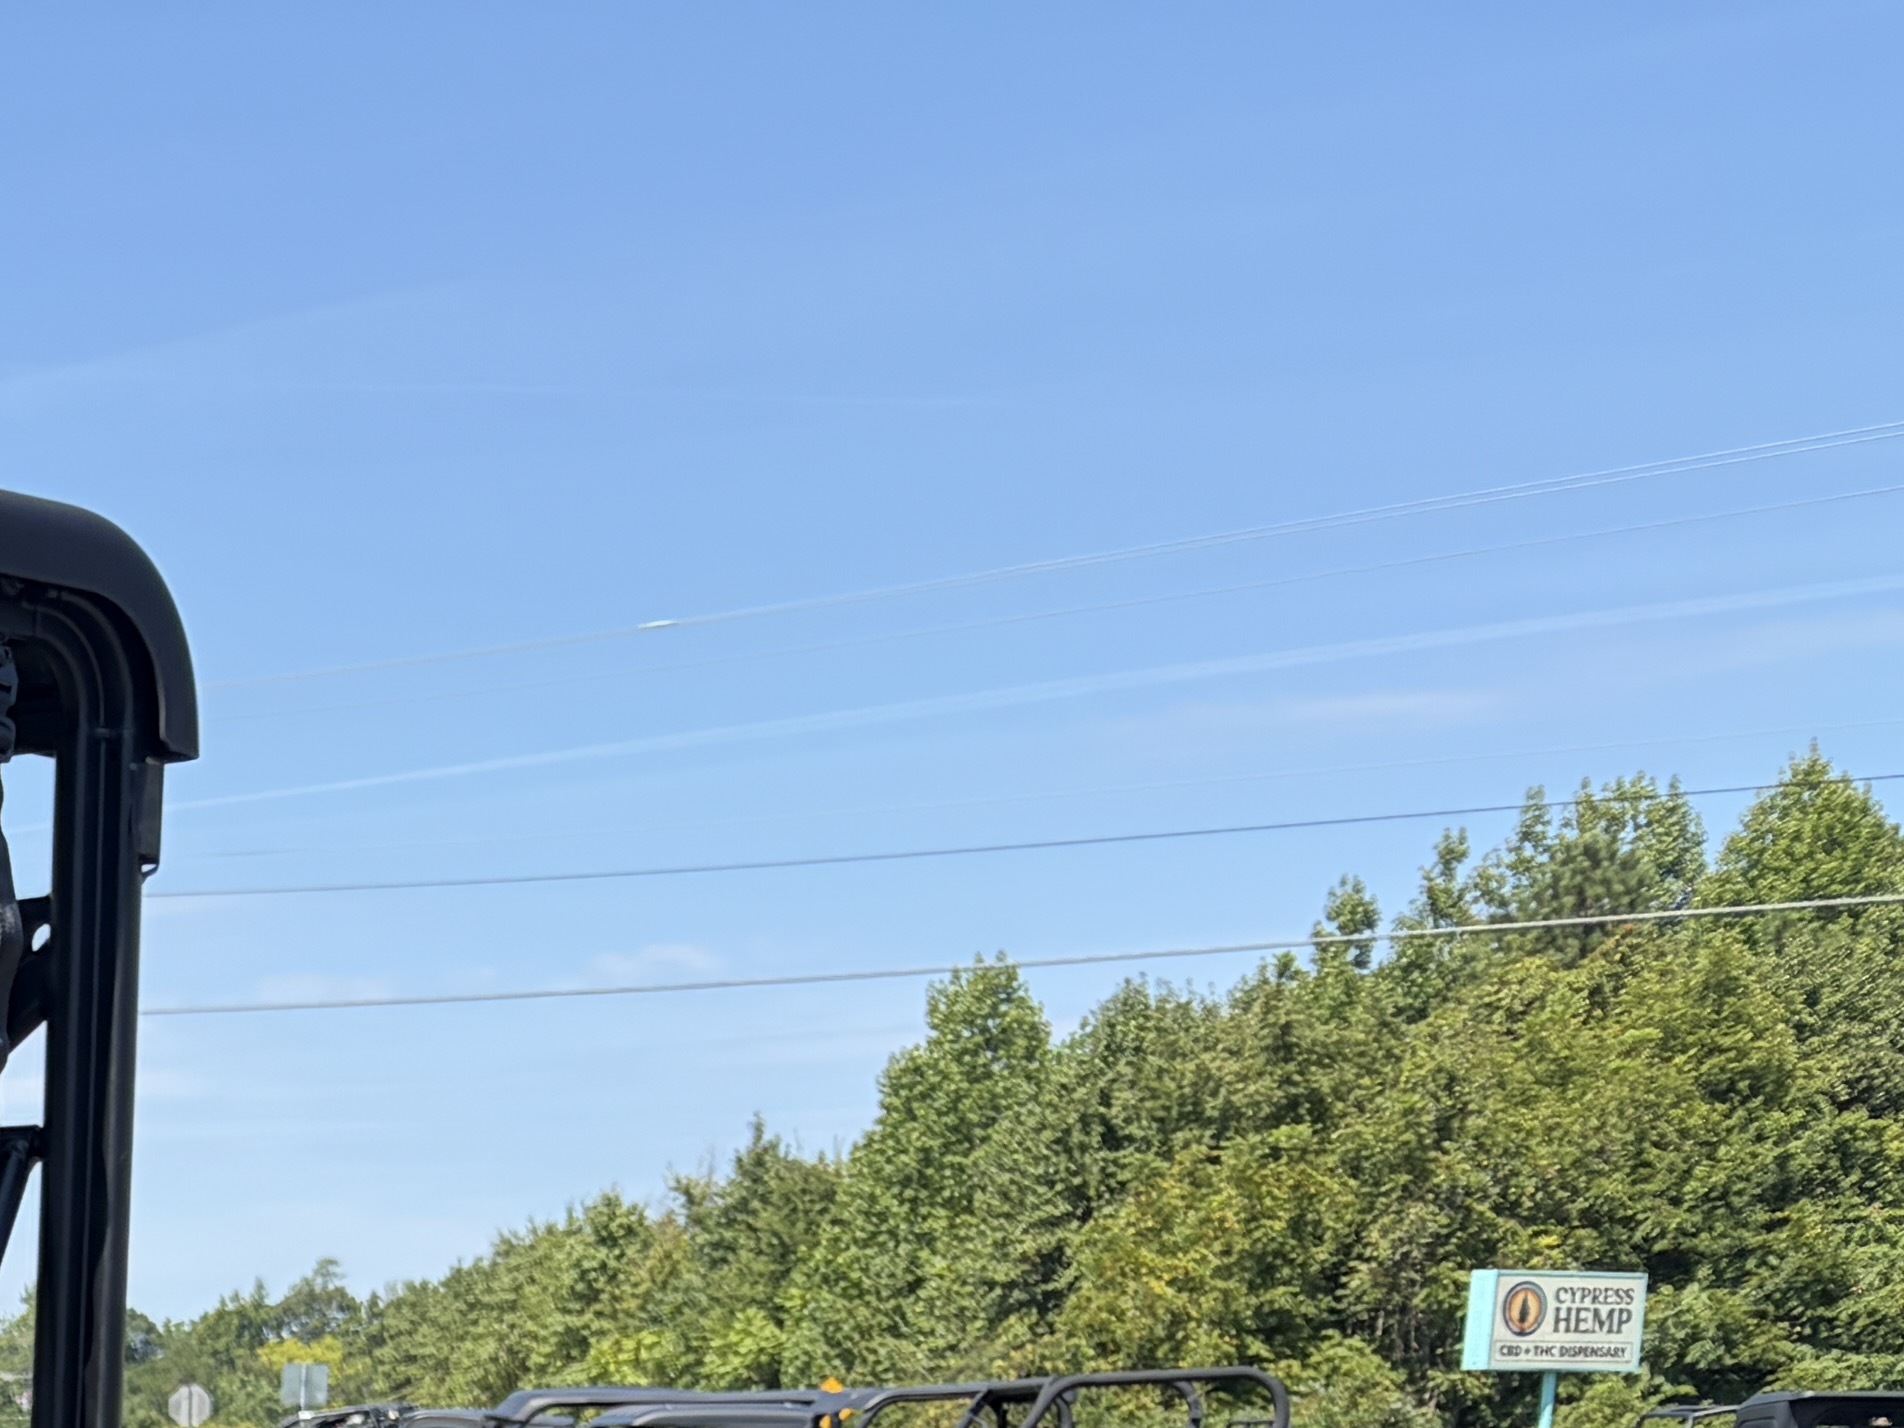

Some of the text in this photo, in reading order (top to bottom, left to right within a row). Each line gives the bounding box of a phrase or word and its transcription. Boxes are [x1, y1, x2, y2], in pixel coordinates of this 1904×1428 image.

[1555, 1286, 1636, 1305] CYPRESS
[1552, 1306, 1634, 1334] HEMP
[1499, 1344, 1523, 1357] CBD
[1533, 1345, 1556, 1358] THC
[1558, 1345, 1628, 1359] DISPENSARY
